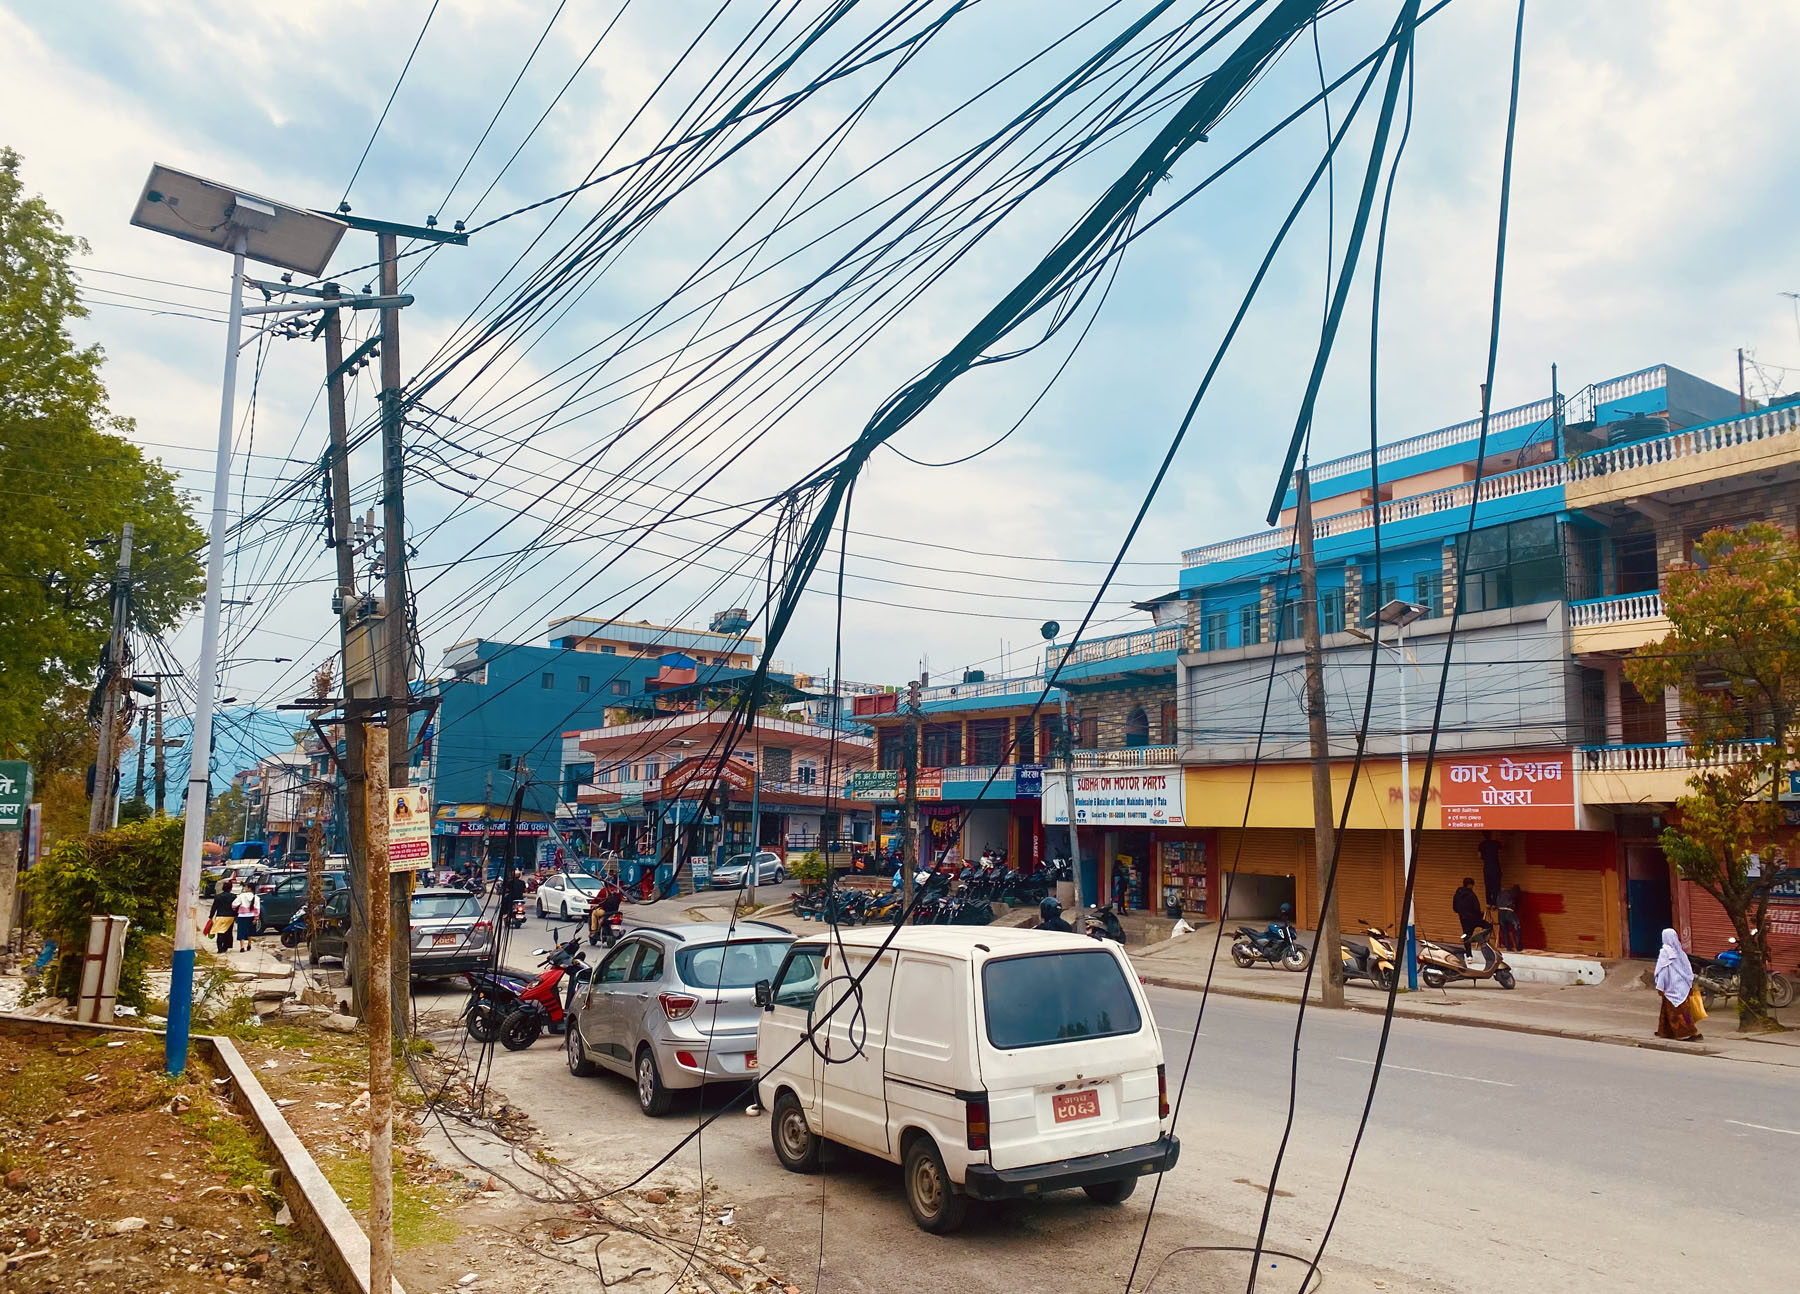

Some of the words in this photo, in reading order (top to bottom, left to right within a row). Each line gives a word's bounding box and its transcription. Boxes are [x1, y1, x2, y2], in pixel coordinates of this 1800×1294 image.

[1450, 764, 1492, 784] कार
[1499, 758, 1563, 783] फेशन
[1101, 776, 1112, 791] OM
[1114, 776, 1140, 791] MOTOR
[1143, 775, 1166, 791] PARTS
[1158, 797, 1167, 806] Tata
[1481, 786, 1533, 805] पोखरा
[692, 857, 707, 865] GFC
